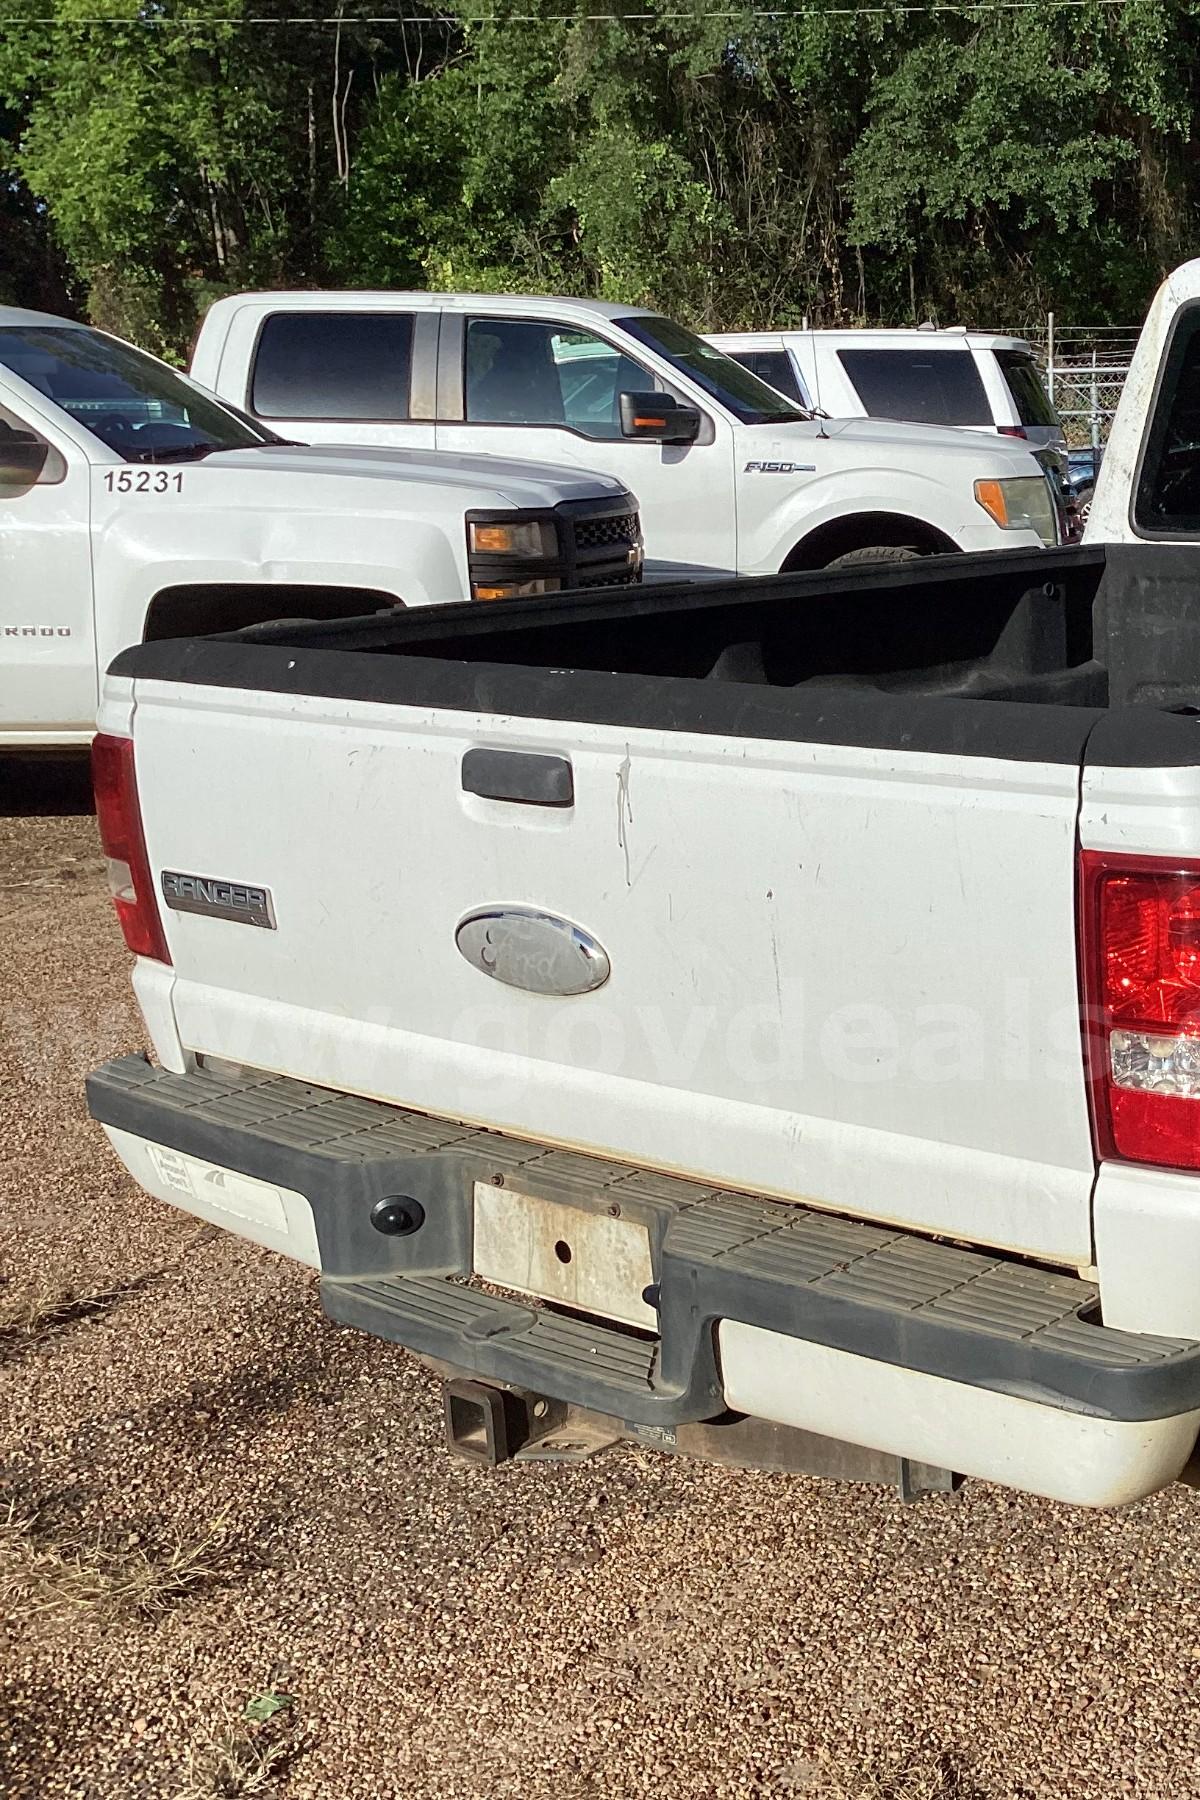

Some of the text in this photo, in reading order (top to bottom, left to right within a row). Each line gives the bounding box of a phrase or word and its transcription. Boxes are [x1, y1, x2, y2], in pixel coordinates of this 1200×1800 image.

[743, 461, 797, 474] F-150
[103, 470, 184, 493] 15231
[0, 625, 71, 637] RADO
[161, 873, 265, 912] RANGER
